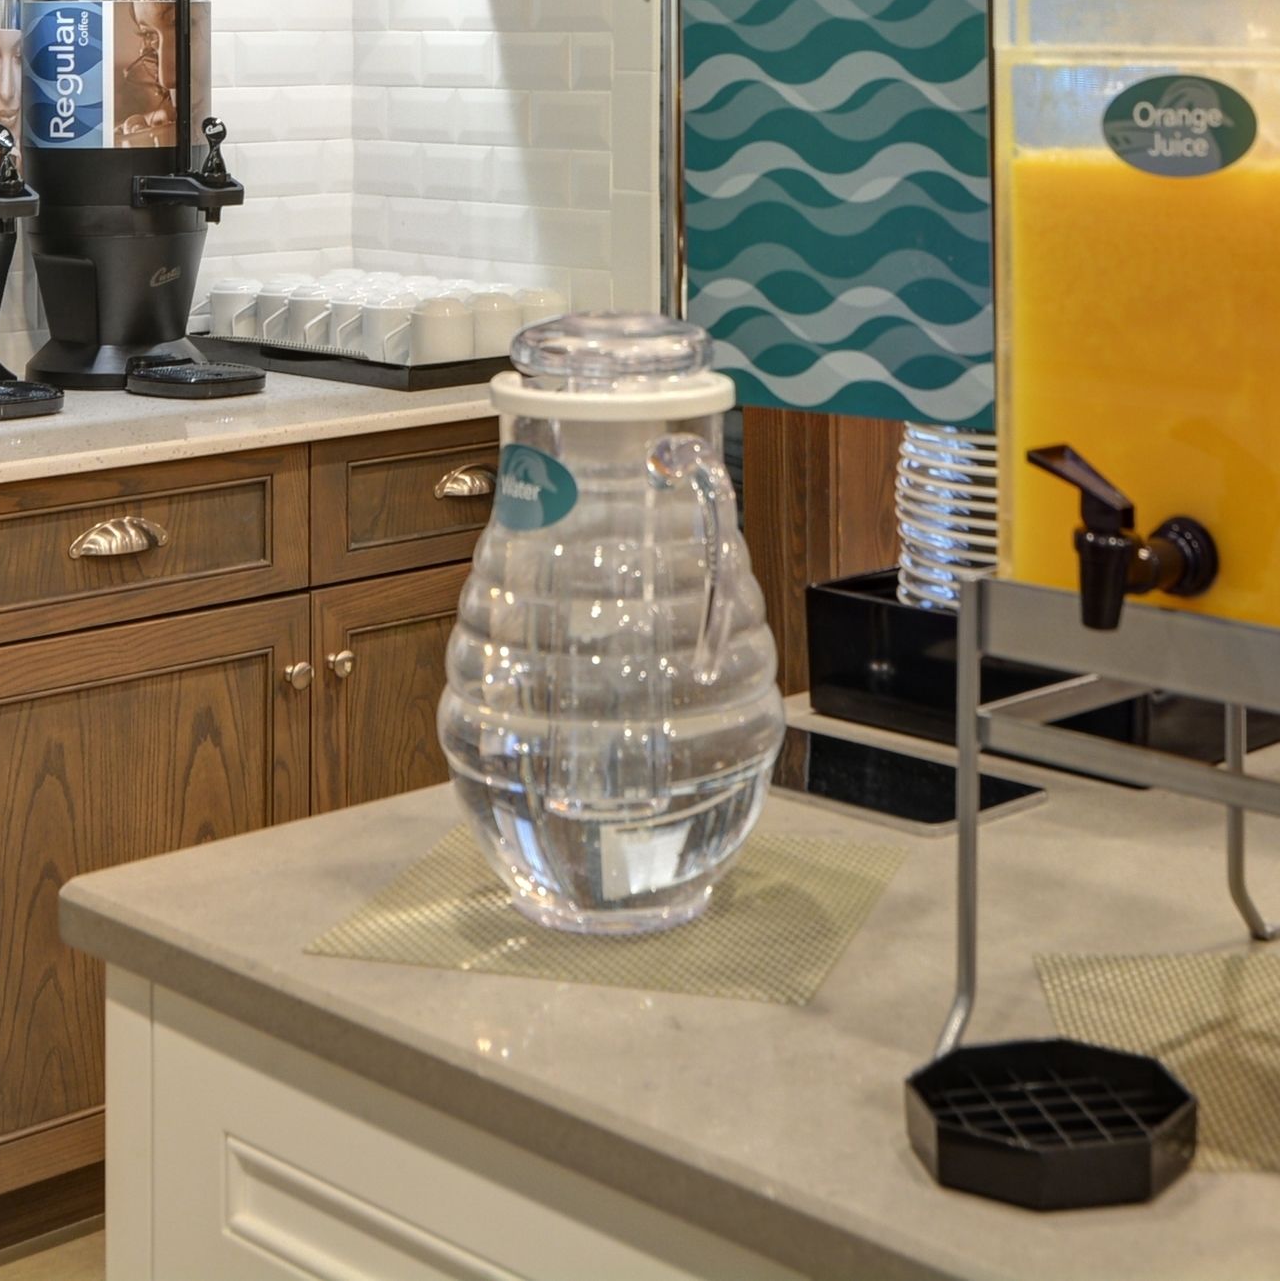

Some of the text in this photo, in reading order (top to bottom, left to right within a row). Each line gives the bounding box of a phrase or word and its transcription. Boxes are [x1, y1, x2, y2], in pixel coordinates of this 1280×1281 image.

[78, 10, 89, 47] Coffee
[48, 11, 84, 139] Regular
[1132, 100, 1224, 135] Orange
[1147, 131, 1210, 158] Juice
[500, 474, 542, 501] Water
